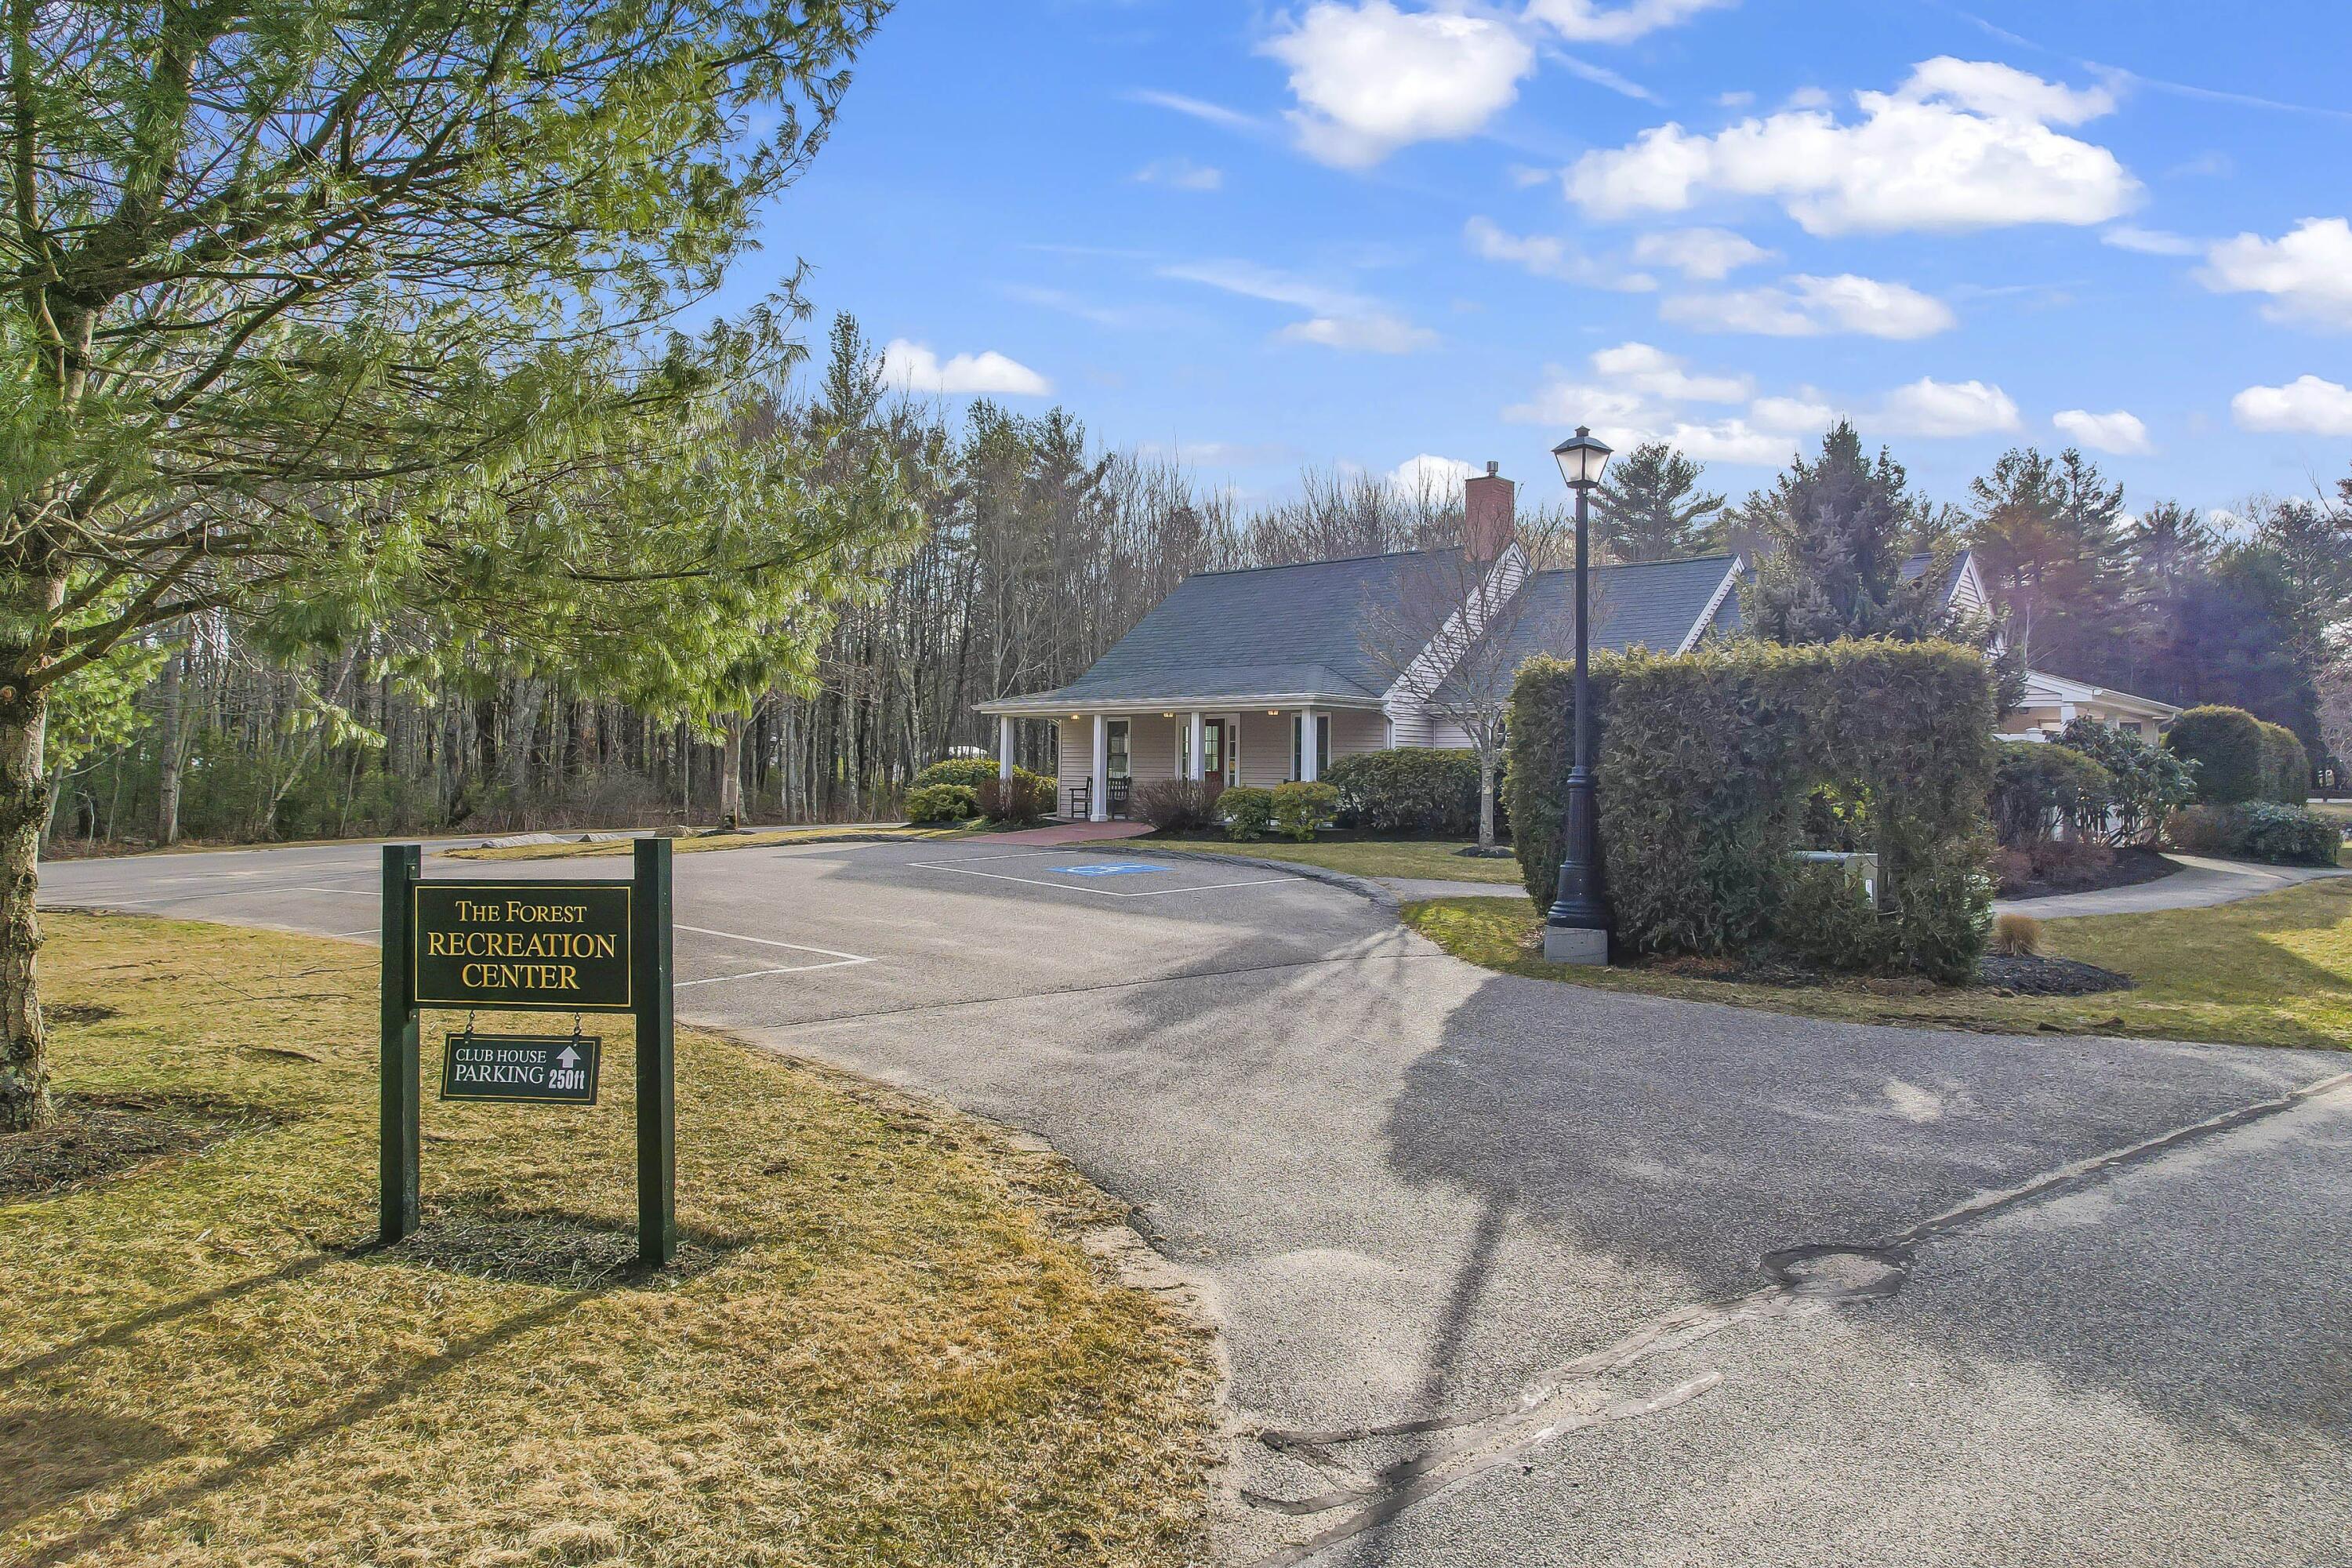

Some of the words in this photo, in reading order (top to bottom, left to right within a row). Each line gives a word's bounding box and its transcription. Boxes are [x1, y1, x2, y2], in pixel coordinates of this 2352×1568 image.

[427, 931, 617, 958] RECREATION
[462, 964, 580, 990] CENTER
[456, 1048, 493, 1062] CLUB
[496, 1050, 546, 1063] HOUSE
[455, 1064, 545, 1084] PARKING
[548, 1069, 585, 1090] 250ft
